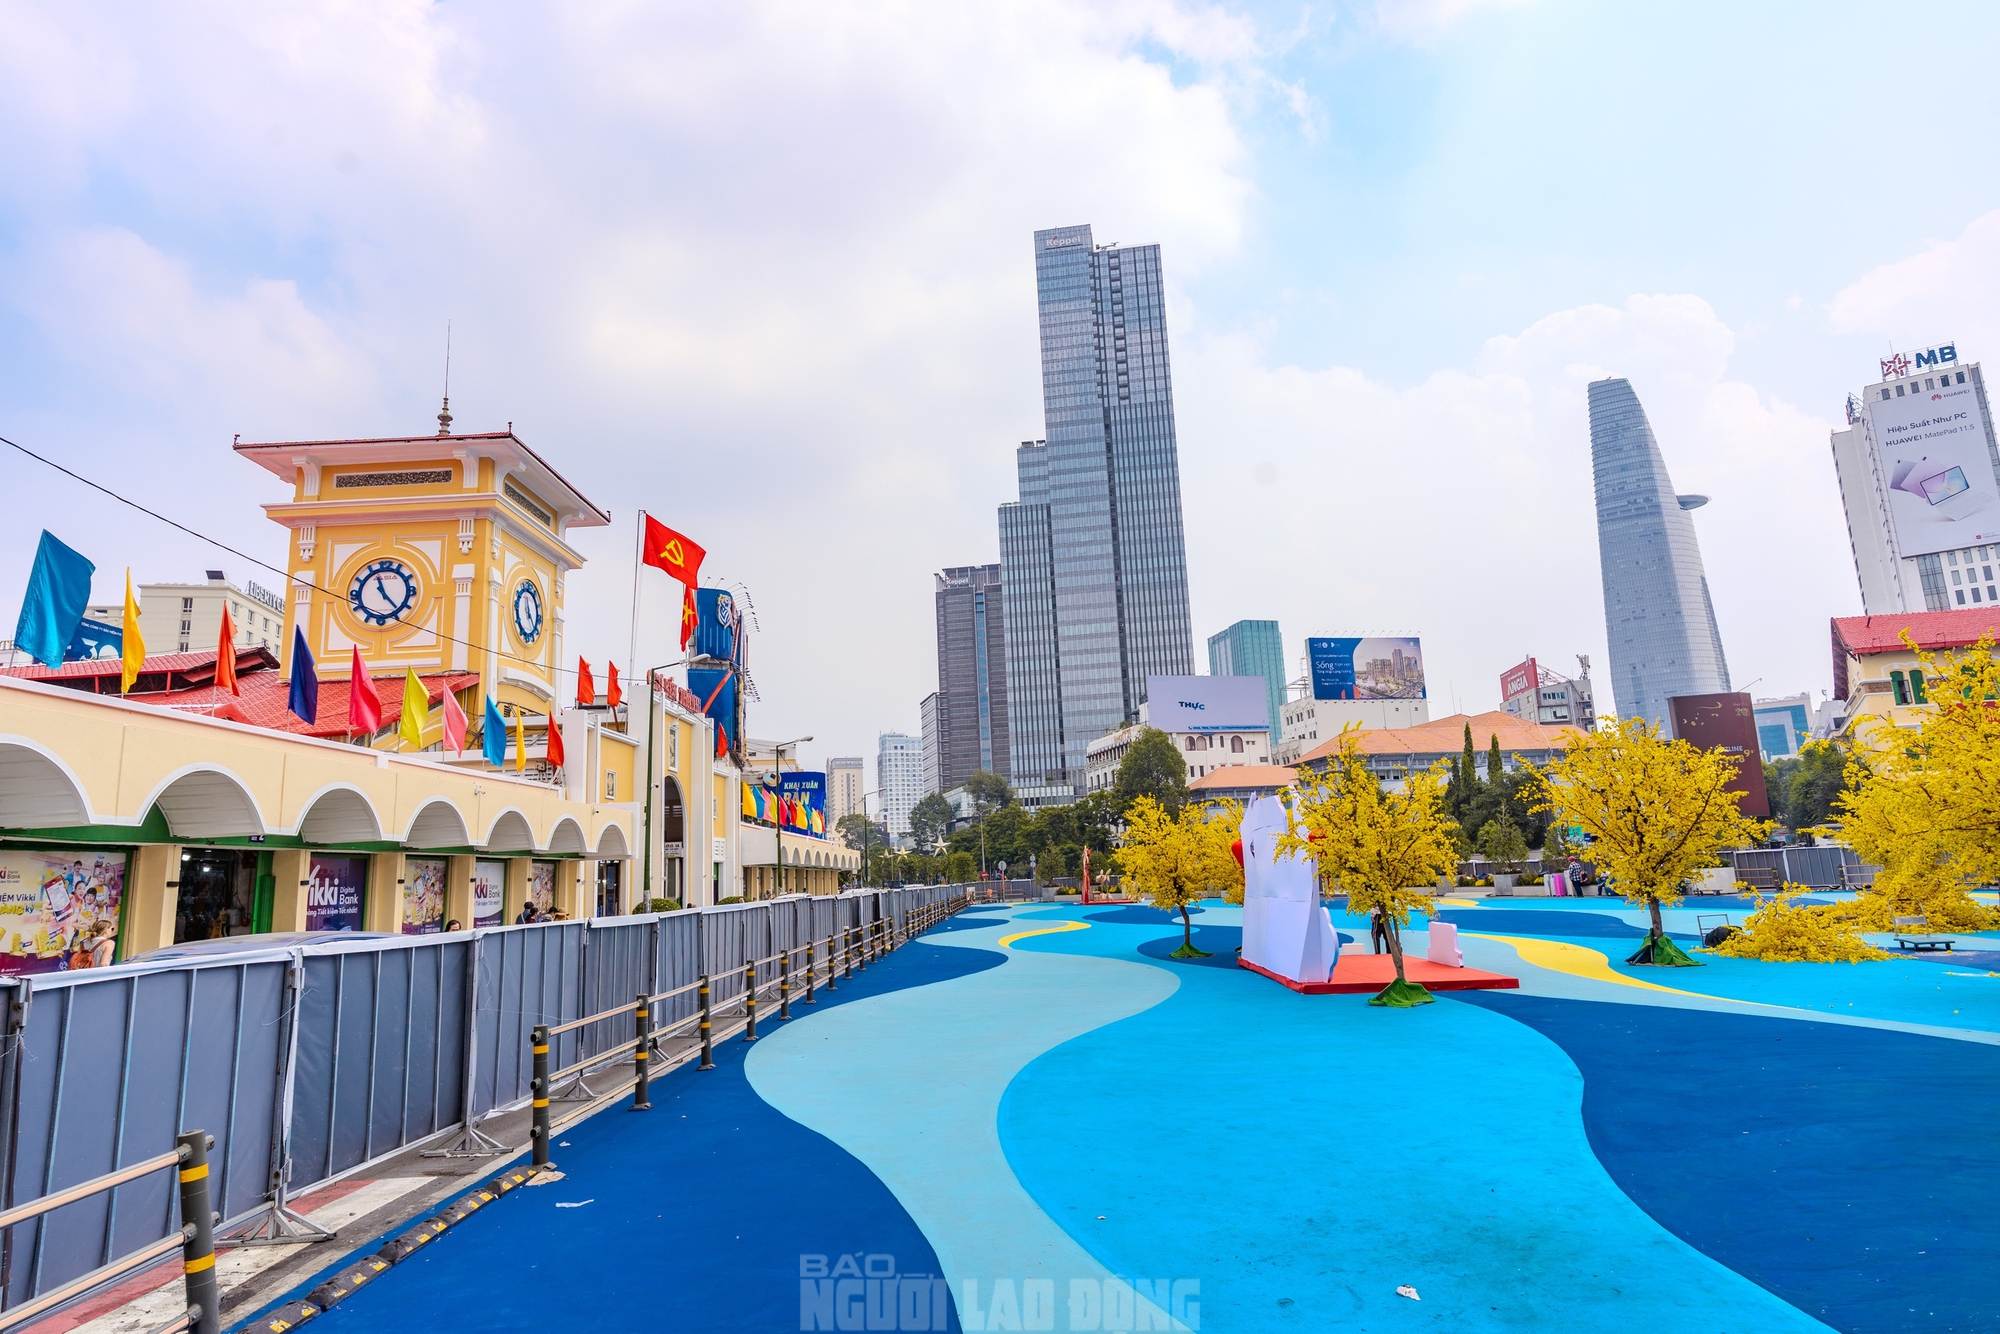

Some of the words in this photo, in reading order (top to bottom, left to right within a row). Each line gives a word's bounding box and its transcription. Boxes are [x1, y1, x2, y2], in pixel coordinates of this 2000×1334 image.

[1046, 236, 1081, 248] Keppel
[1916, 346, 1957, 368] MB
[1943, 389, 1970, 398] HUAWEI
[1887, 425, 1908, 434] Hiệu
[1909, 419, 1931, 430] Suất
[1932, 415, 1952, 425] Như
[1954, 412, 1967, 420] PC
[1885, 434, 1922, 447] HUAWEI
[1924, 428, 1958, 439] MatePad
[1959, 424, 1975, 432] 11.5
[1179, 701, 1205, 710] THỰC
[802, 780, 818, 789] XUÂN
[474, 877, 489, 899] kki
[340, 894, 358, 905] Bank
[489, 890, 500, 899] Bank
